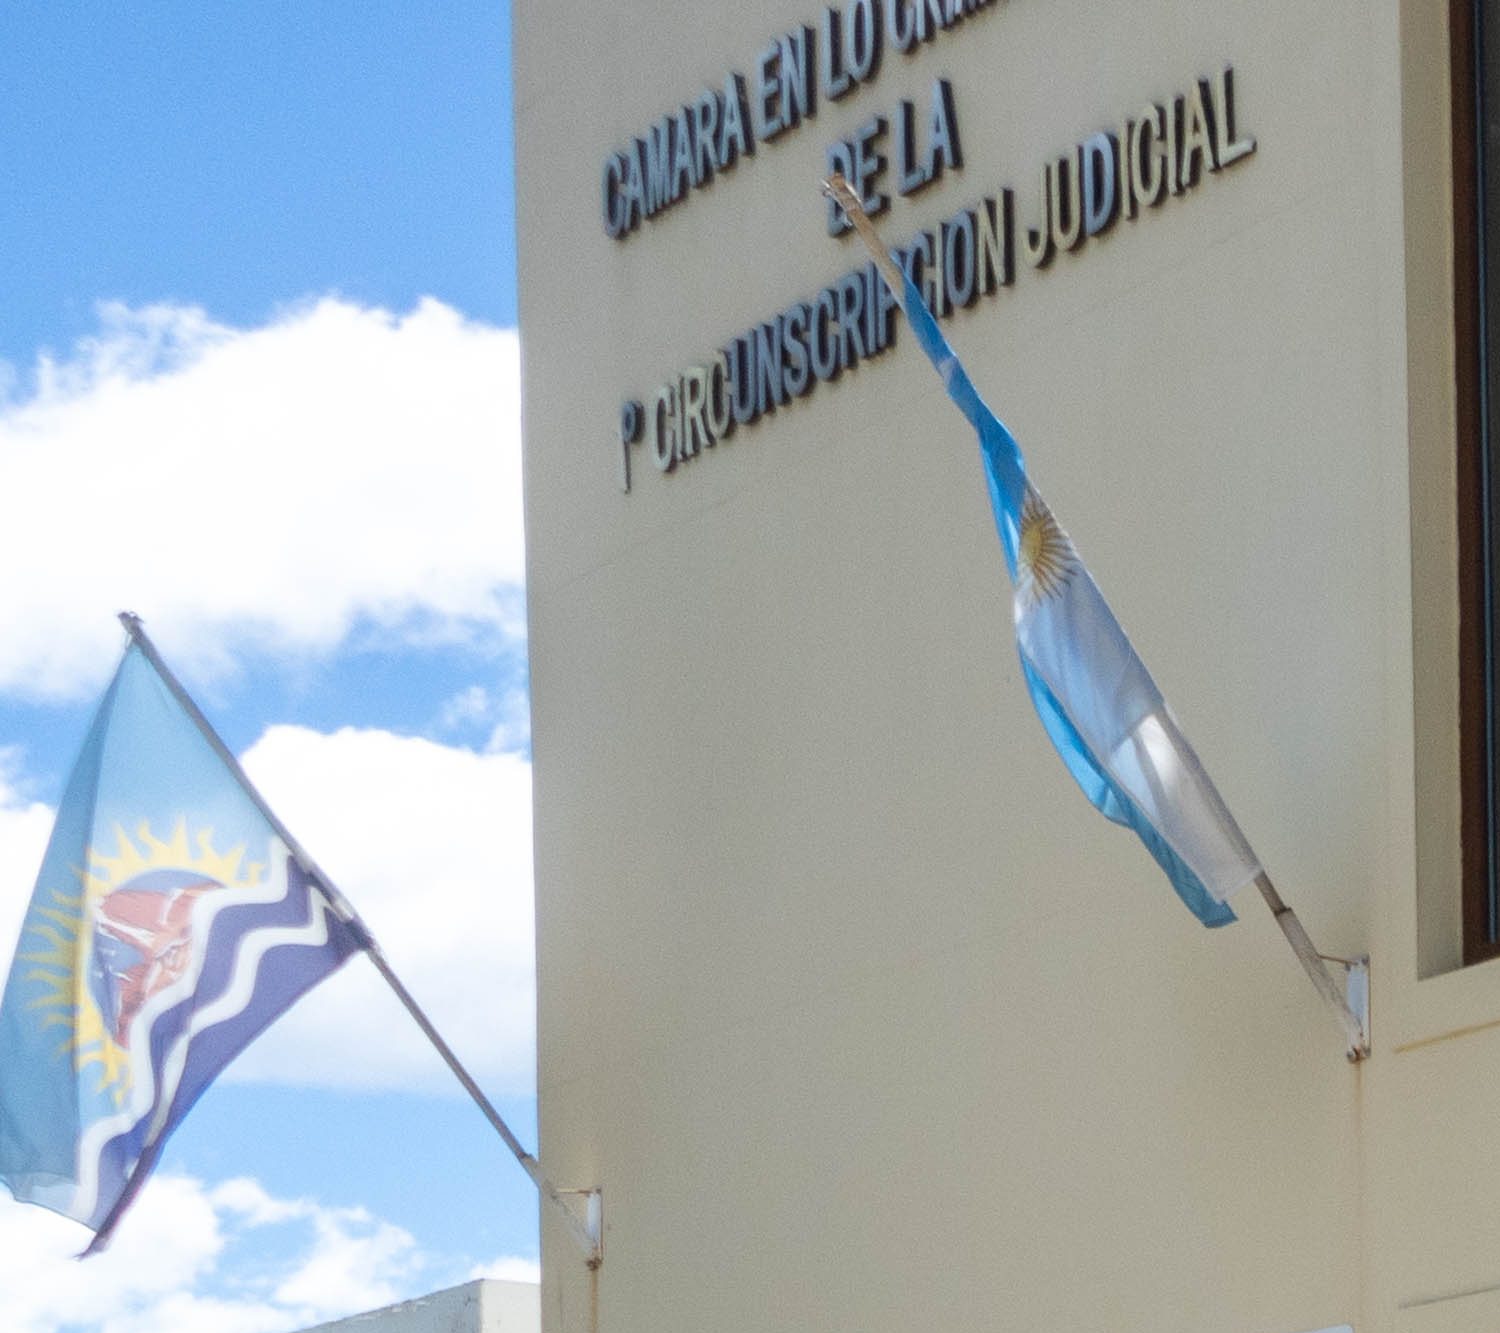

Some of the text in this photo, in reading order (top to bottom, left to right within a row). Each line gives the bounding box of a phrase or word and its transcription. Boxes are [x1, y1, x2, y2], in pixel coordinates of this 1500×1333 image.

[602, 71, 753, 239] CAMARA
[756, 25, 815, 142] EN
[821, 0, 881, 99] LO
[826, 79, 963, 236] DE LA
[1023, 65, 1257, 269] JUDICIAL
